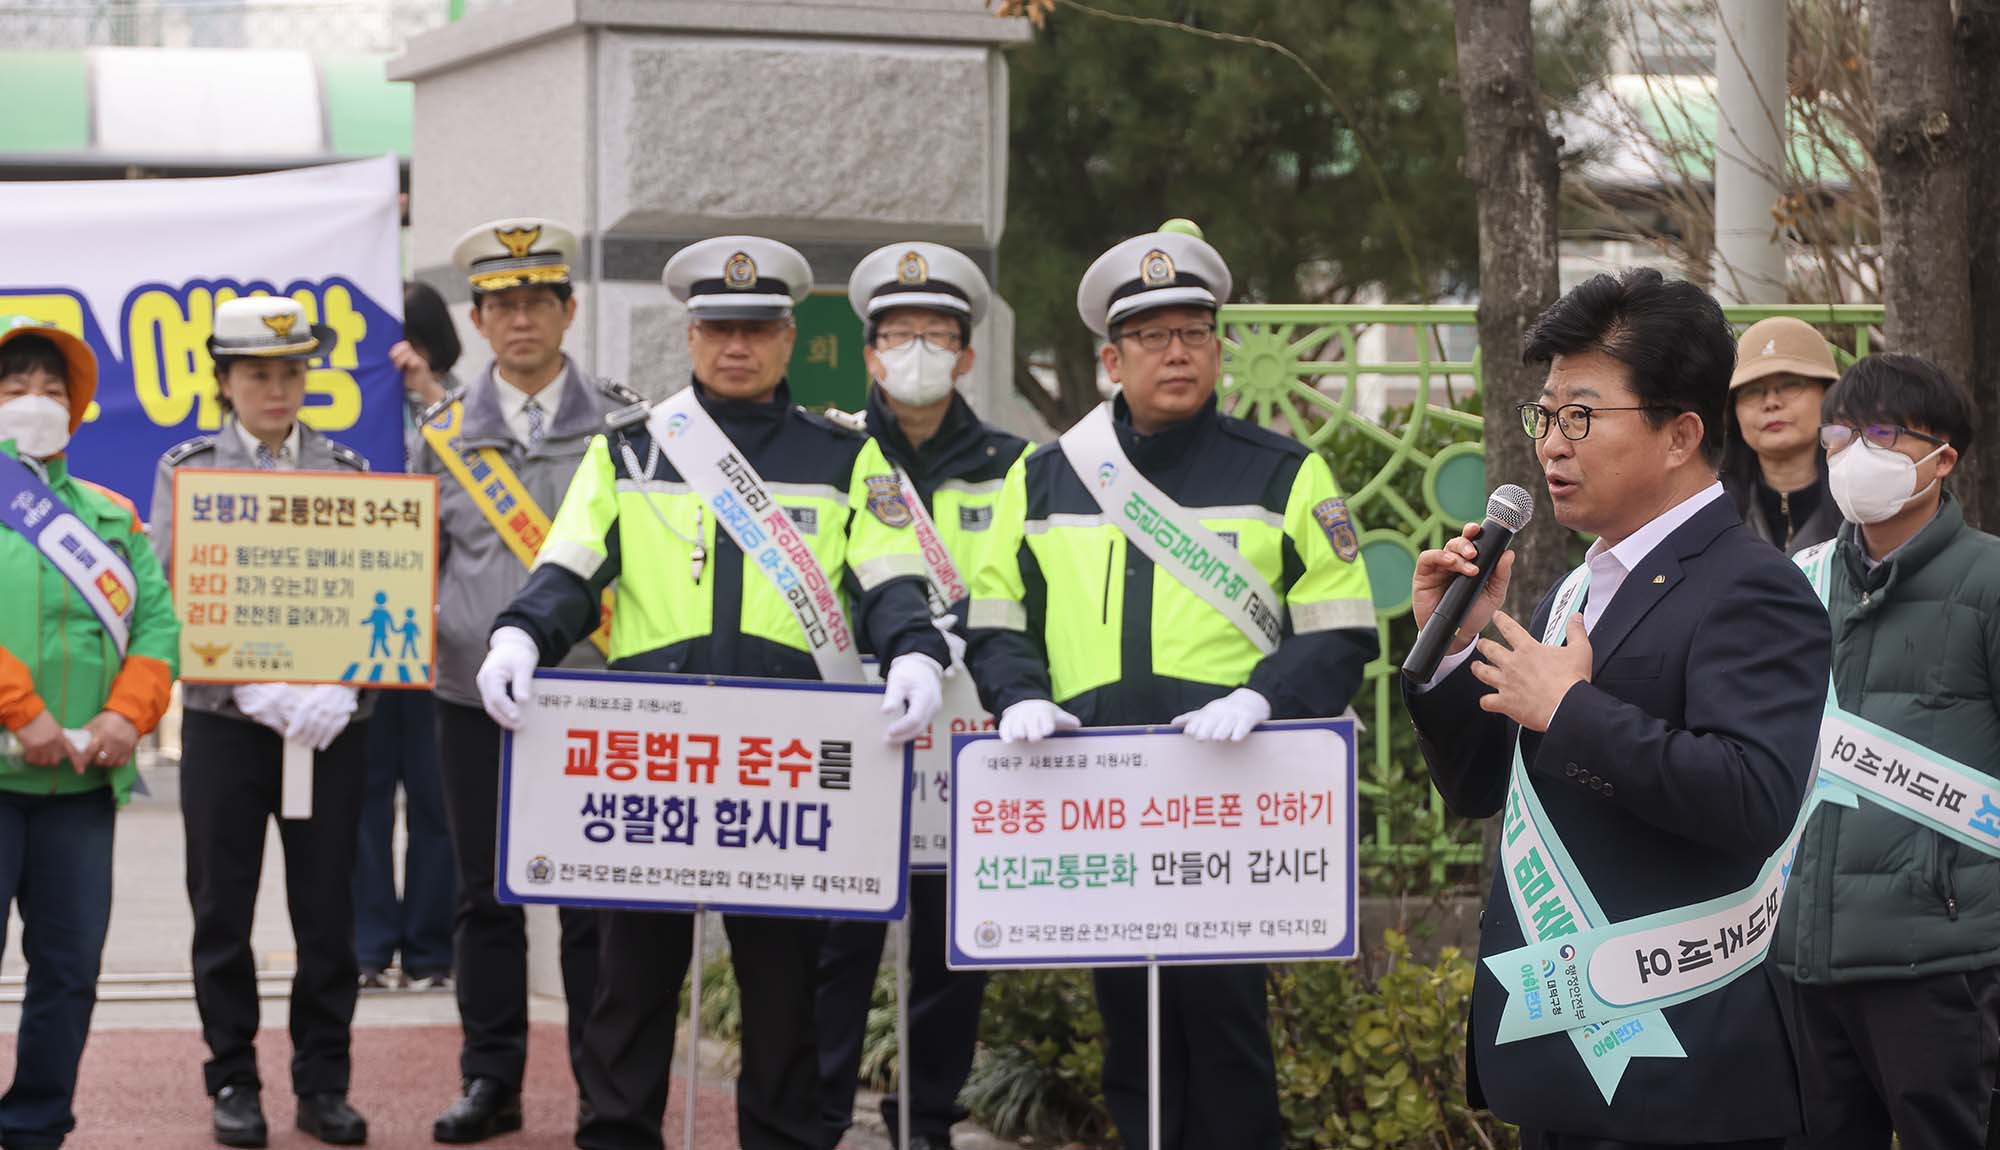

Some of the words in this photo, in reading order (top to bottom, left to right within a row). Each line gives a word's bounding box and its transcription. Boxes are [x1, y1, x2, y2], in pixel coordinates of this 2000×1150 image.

[717, 453, 771, 512] 편리한
[191, 493, 260, 524] 보행자
[267, 496, 356, 528] 교통안전
[363, 499, 422, 529] 3수칙
[712, 488, 767, 549] 안전이
[189, 544, 228, 567] 서다
[235, 546, 300, 569] 횡단보도
[305, 547, 354, 570] 앞에서
[359, 549, 424, 571] 멈춰서기
[1123, 491, 1248, 601] 어린이보호구역
[189, 574, 228, 596] 보다
[234, 575, 266, 596] 차가
[271, 576, 318, 598] 오는지
[323, 578, 354, 599] 보기
[759, 547, 829, 649] 우선입니다
[188, 603, 228, 625] 걷다
[234, 604, 281, 625] 천천히
[286, 606, 349, 627] 걸어가기
[577, 696, 634, 712] 사회보조금
[564, 728, 720, 784] 교통법규
[738, 736, 854, 790] 준수를
[1029, 754, 1088, 770] 사회보조금
[1831, 735, 1967, 813] 보내주세요
[581, 792, 698, 847] 생활화
[714, 797, 832, 852] 합시다
[971, 799, 1048, 835] 운행중
[1061, 799, 1126, 831] DMB
[1140, 792, 1243, 829] 스마트폰
[1256, 790, 1333, 827] 안하기
[557, 863, 732, 888] 전국모범운전자연합회
[738, 871, 806, 892] 대전지부
[812, 874, 881, 895] 대덕지회
[975, 852, 1138, 890] 선진교통문화
[1151, 849, 1233, 886] 만들어
[1248, 847, 1329, 883] 갑시다
[1008, 922, 1178, 942] 전국모범운전자연합회
[1185, 920, 1253, 939] 대전지부
[1259, 918, 1328, 937] 대덕지회
[1636, 887, 1779, 984] 보내주세요
[1547, 979, 1563, 1016] 대덕구청
[1565, 964, 1586, 1020] 행정안전부
